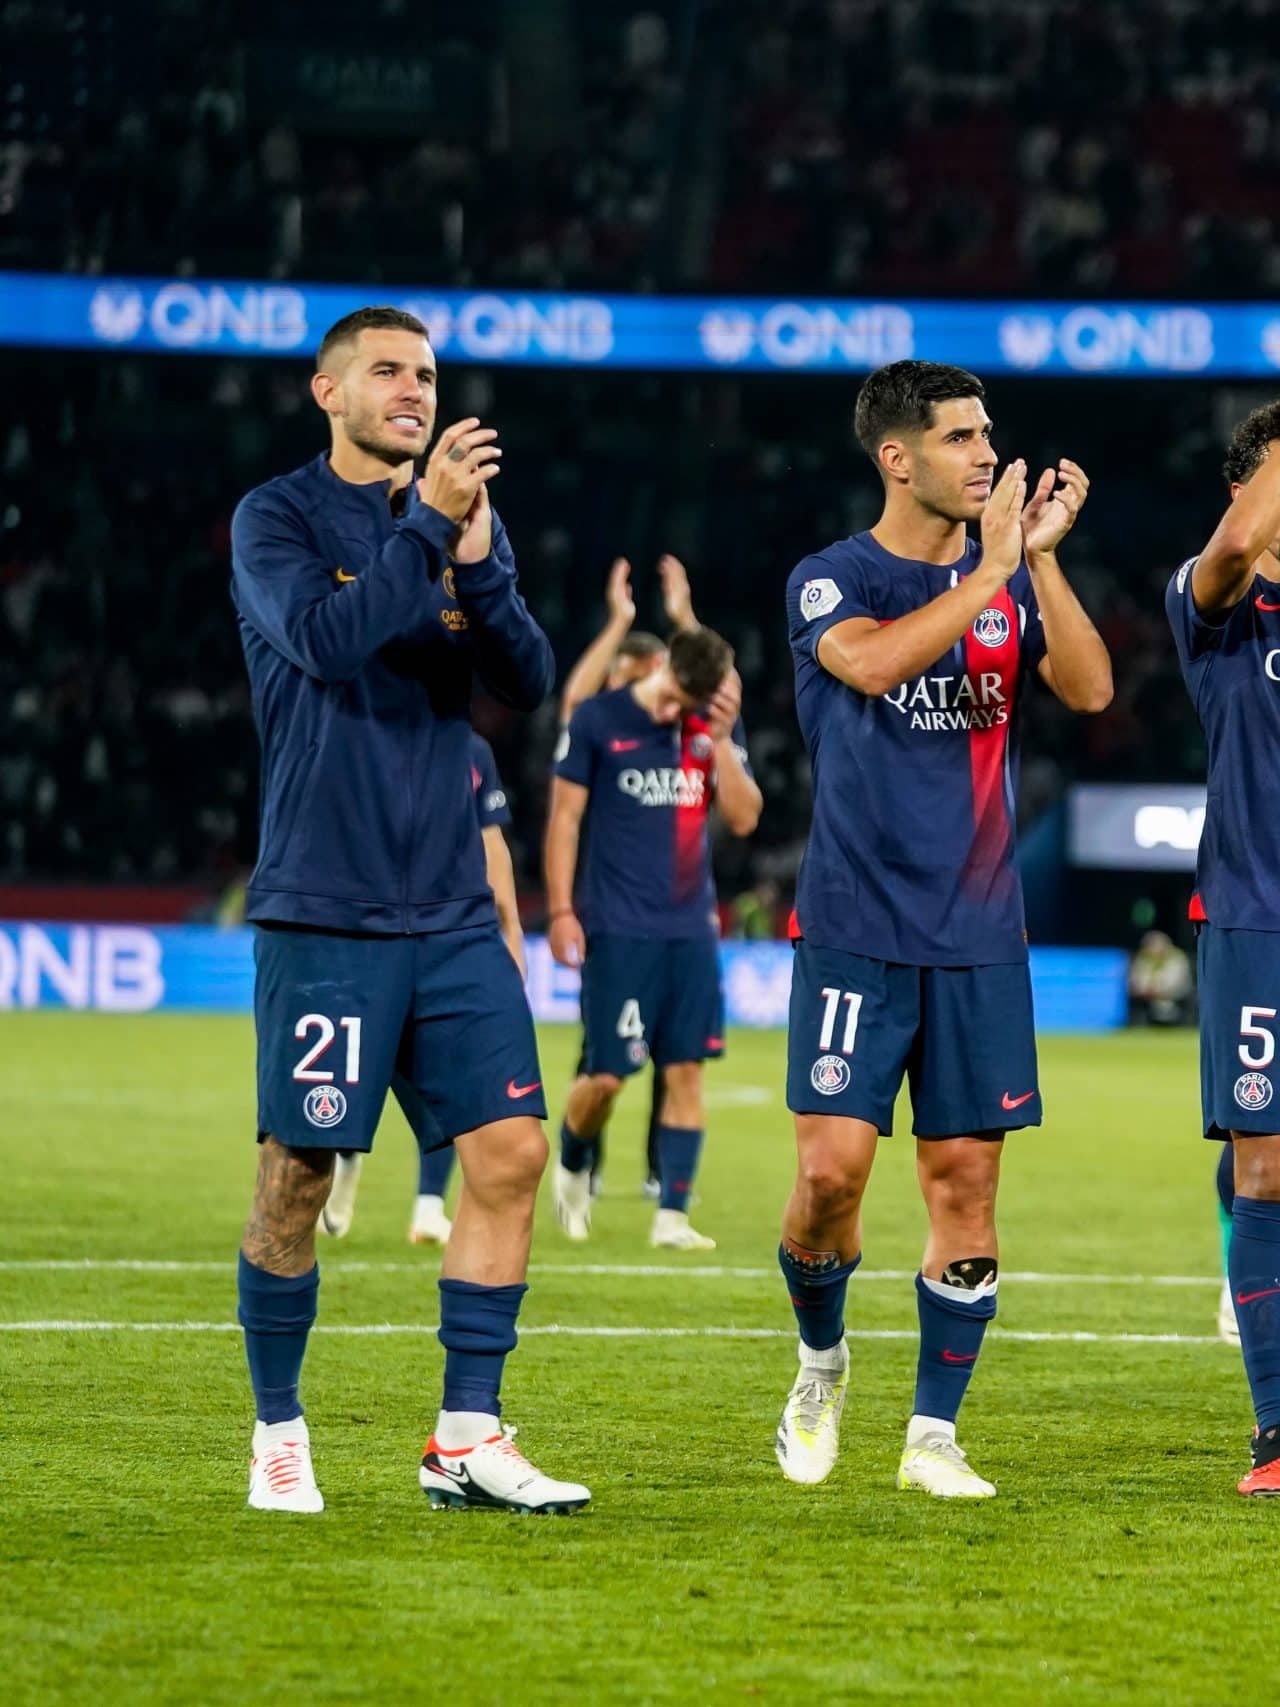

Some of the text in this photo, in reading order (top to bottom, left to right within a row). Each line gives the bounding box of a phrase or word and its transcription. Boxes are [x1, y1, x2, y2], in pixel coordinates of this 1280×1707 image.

[151, 283, 307, 350] QNB
[459, 294, 614, 361] QNB
[759, 303, 913, 368] QNB
[1060, 306, 1214, 371] QNB
[910, 705, 1008, 730] AIRWAYS
[617, 767, 705, 799] QATAR
[0, 922, 165, 1013] NB
[293, 1013, 362, 1084] 21
[617, 998, 645, 1039] 4
[819, 987, 863, 1055] 11
[1238, 1005, 1277, 1070] 5
